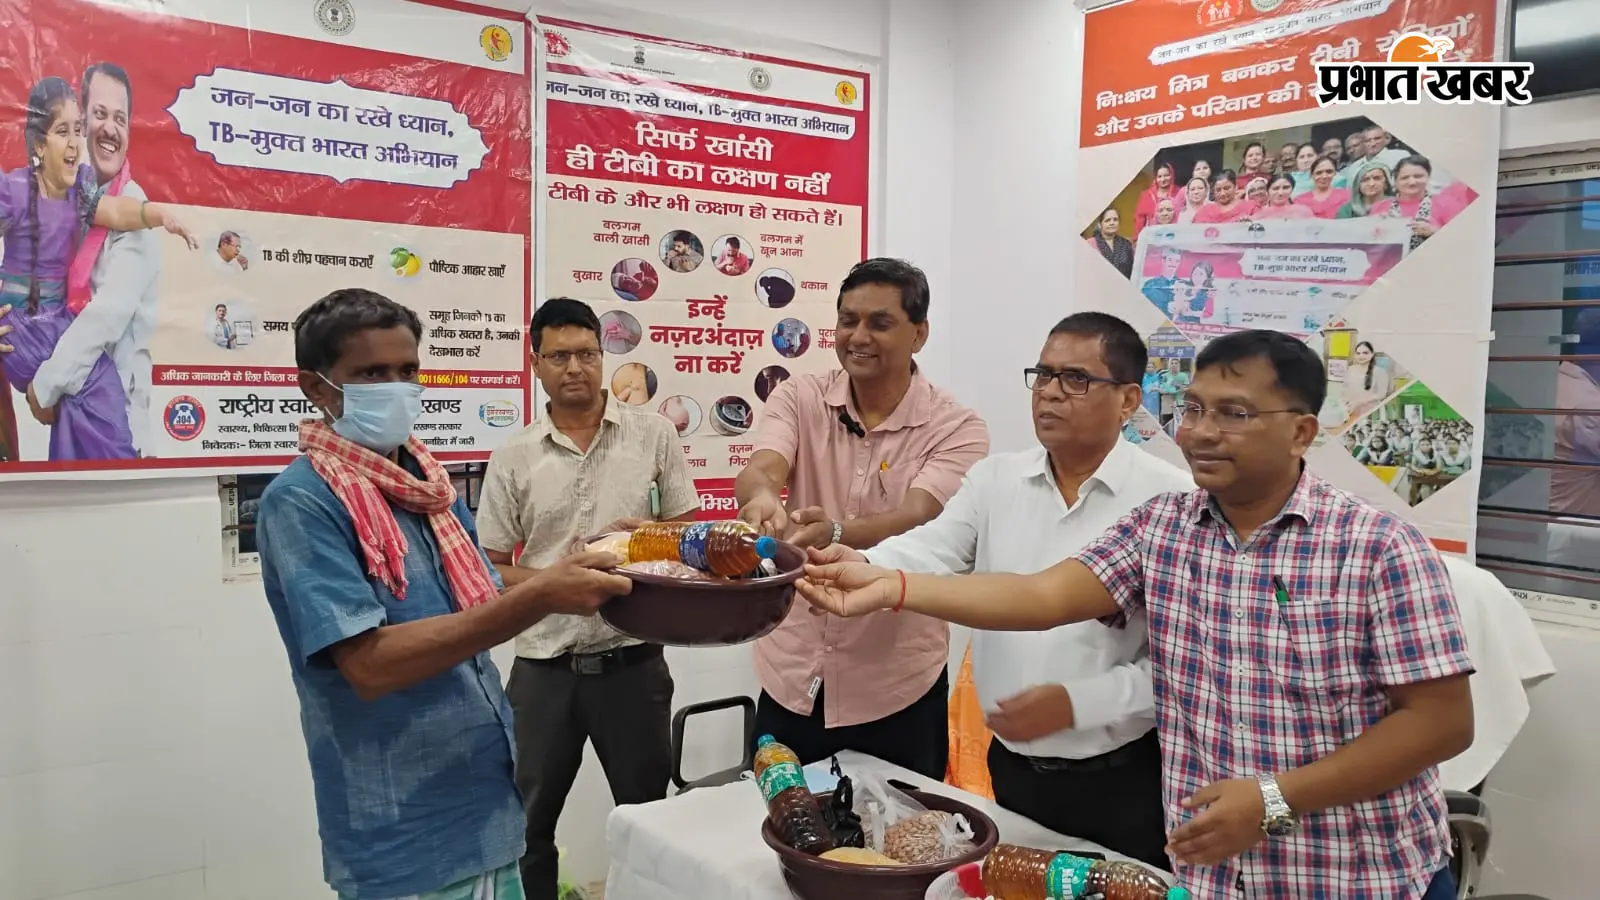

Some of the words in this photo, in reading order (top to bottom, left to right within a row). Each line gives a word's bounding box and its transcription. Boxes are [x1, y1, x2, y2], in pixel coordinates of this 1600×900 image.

[1167, 71, 1208, 96] मित्र
[1222, 56, 1296, 85] बनकर
[1309, 38, 1360, 65] टीबी
[211, 87, 311, 117] जन-जन
[317, 101, 349, 122] का
[355, 105, 392, 128] रखे
[398, 113, 454, 138] ध्यान,
[610, 89, 630, 105] का
[635, 92, 660, 108] रखे
[663, 98, 703, 116] ध्यान,
[708, 103, 761, 123] TB-मुक्त
[765, 111, 798, 128] भारत
[801, 116, 850, 135] अभियान
[1095, 118, 1130, 137] और
[1133, 105, 1187, 130] उनके
[1190, 91, 1262, 119] परिवार
[1268, 82, 1303, 105] की
[209, 121, 305, 154] TB-मुक्त
[312, 137, 368, 160] भारत
[375, 143, 458, 170] अभियान
[635, 121, 698, 150] सिर्फ
[704, 133, 773, 161] खांसी
[565, 145, 598, 170] ही
[603, 148, 660, 176] टीबी
[667, 159, 705, 181] का
[711, 166, 778, 190] लक्षण
[784, 172, 832, 196] नहीं
[548, 182, 589, 202] टीबी
[596, 186, 617, 205] के
[624, 190, 661, 209] और
[667, 193, 690, 212] भी
[695, 200, 744, 217] लक्षण
[749, 202, 767, 220] हो
[772, 205, 820, 223] सकते
[602, 219, 642, 233] बलगम
[593, 230, 620, 245] वाली
[760, 233, 793, 246] बलगम
[794, 232, 804, 246] में
[263, 249, 273, 261] TB
[275, 249, 289, 263] की
[292, 249, 312, 265] शीघ्र
[314, 252, 347, 267] पहचान
[760, 245, 779, 259] खून
[780, 246, 804, 258] आना
[429, 261, 459, 277] पौष्टिक
[461, 264, 486, 278] आहार
[572, 269, 603, 284] बुखार
[800, 280, 828, 292] थकान
[429, 310, 451, 323] समूह
[453, 309, 482, 321] जिनको
[493, 313, 506, 322] का
[686, 294, 729, 321] इन्हें
[263, 320, 288, 332] समय
[429, 326, 456, 339] अधिक
[458, 329, 482, 340] खतरा
[496, 329, 520, 341] उनकी
[649, 323, 765, 349] नज़रअंदाज़
[429, 344, 464, 357] देखभाल
[465, 345, 480, 357] करें
[673, 355, 703, 374] ना
[706, 351, 745, 375] करें
[160, 369, 189, 381] अधिक
[191, 370, 231, 381] जानकारी
[233, 370, 242, 381] के
[245, 370, 261, 383] लिए
[263, 371, 285, 382] जिला
[218, 393, 274, 418] राष्ट्रीय
[253, 423, 287, 433] चिकित्सा
[248, 439, 271, 449] जिला
[449, 436, 458, 445] में
[458, 436, 475, 446] जारी
